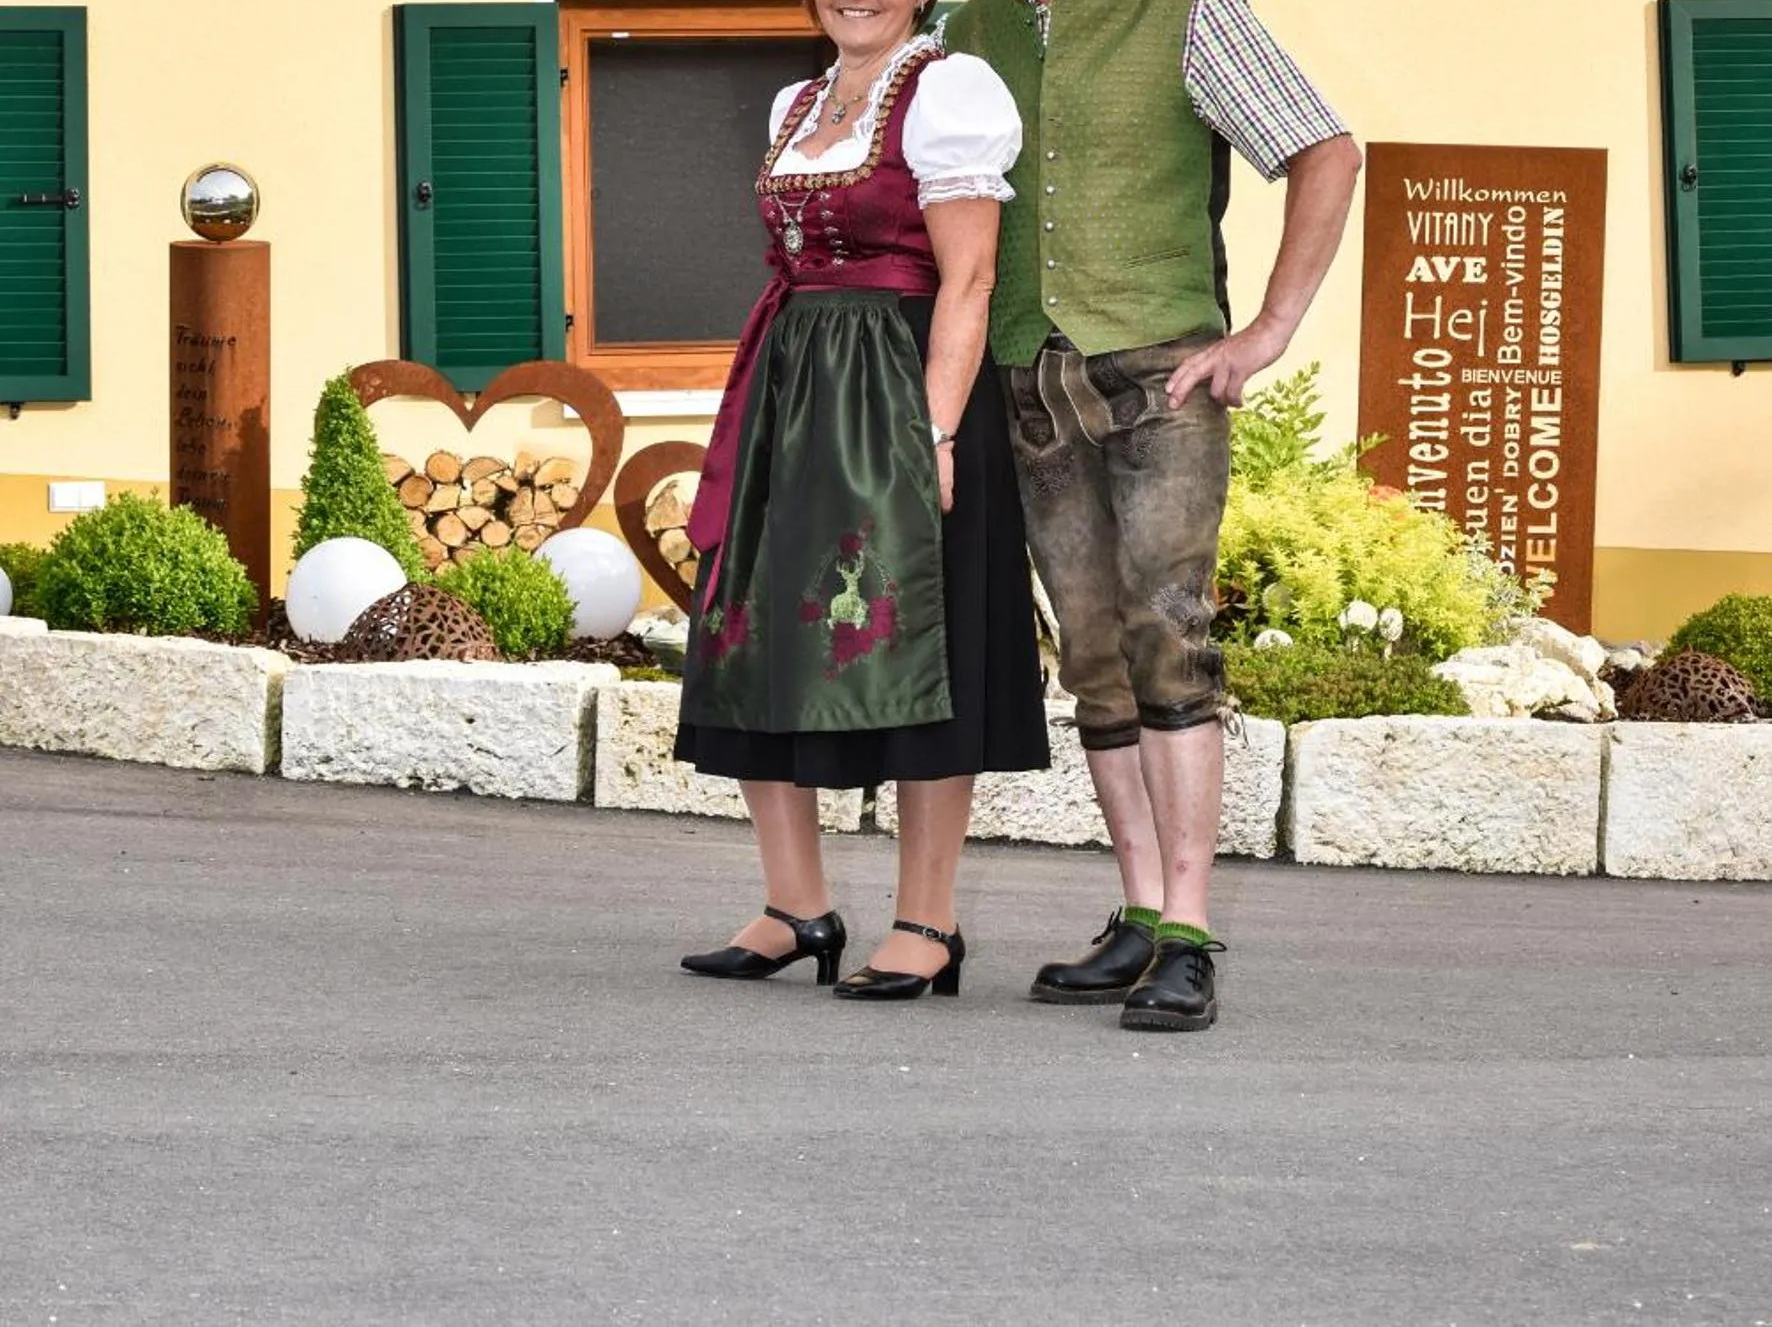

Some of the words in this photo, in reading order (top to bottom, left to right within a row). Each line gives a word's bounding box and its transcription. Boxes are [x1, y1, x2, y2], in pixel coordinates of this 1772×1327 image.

[1403, 177, 1568, 203] Willkommen
[1406, 210, 1494, 246] VITANY
[1404, 255, 1489, 283] AVE
[1497, 204, 1527, 364] Bem-vindo
[1538, 206, 1565, 366] HOSGELDIN
[1404, 291, 1488, 358] Hej
[1461, 367, 1563, 385] BIENVENUE
[1459, 387, 1493, 447] dia
[1502, 385, 1523, 478] DOBRY
